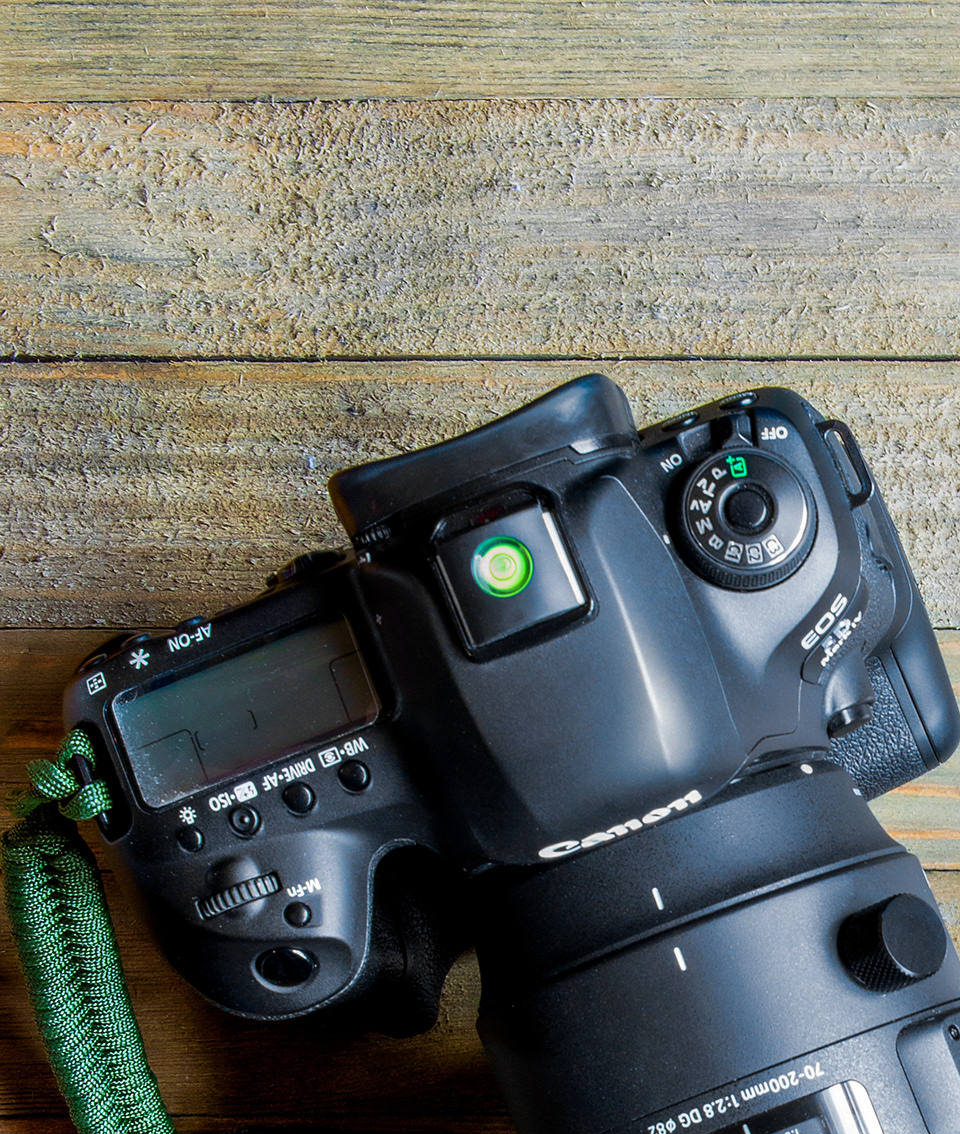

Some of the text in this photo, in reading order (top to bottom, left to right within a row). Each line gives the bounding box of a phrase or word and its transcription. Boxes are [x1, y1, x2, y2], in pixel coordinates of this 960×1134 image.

[761, 426, 788, 441] OFF
[660, 454, 682, 473] ON
[711, 467, 727, 480] P
[697, 478, 716, 498] Tv
[690, 500, 712, 514] Av
[696, 519, 714, 535] M
[709, 534, 724, 551] B
[726, 542, 743, 563] C1
[746, 543, 764, 564] C2
[801, 593, 848, 649] EOS
[168, 623, 212, 652] AF-ON
[821, 627, 852, 667] Mark
[538, 789, 702, 858] Canon
[286, 878, 321, 898] M-Fn
[741, 1062, 825, 1102] 70-200mm
[702, 1094, 739, 1119] 1:2.8
[679, 1109, 701, 1128] DG
